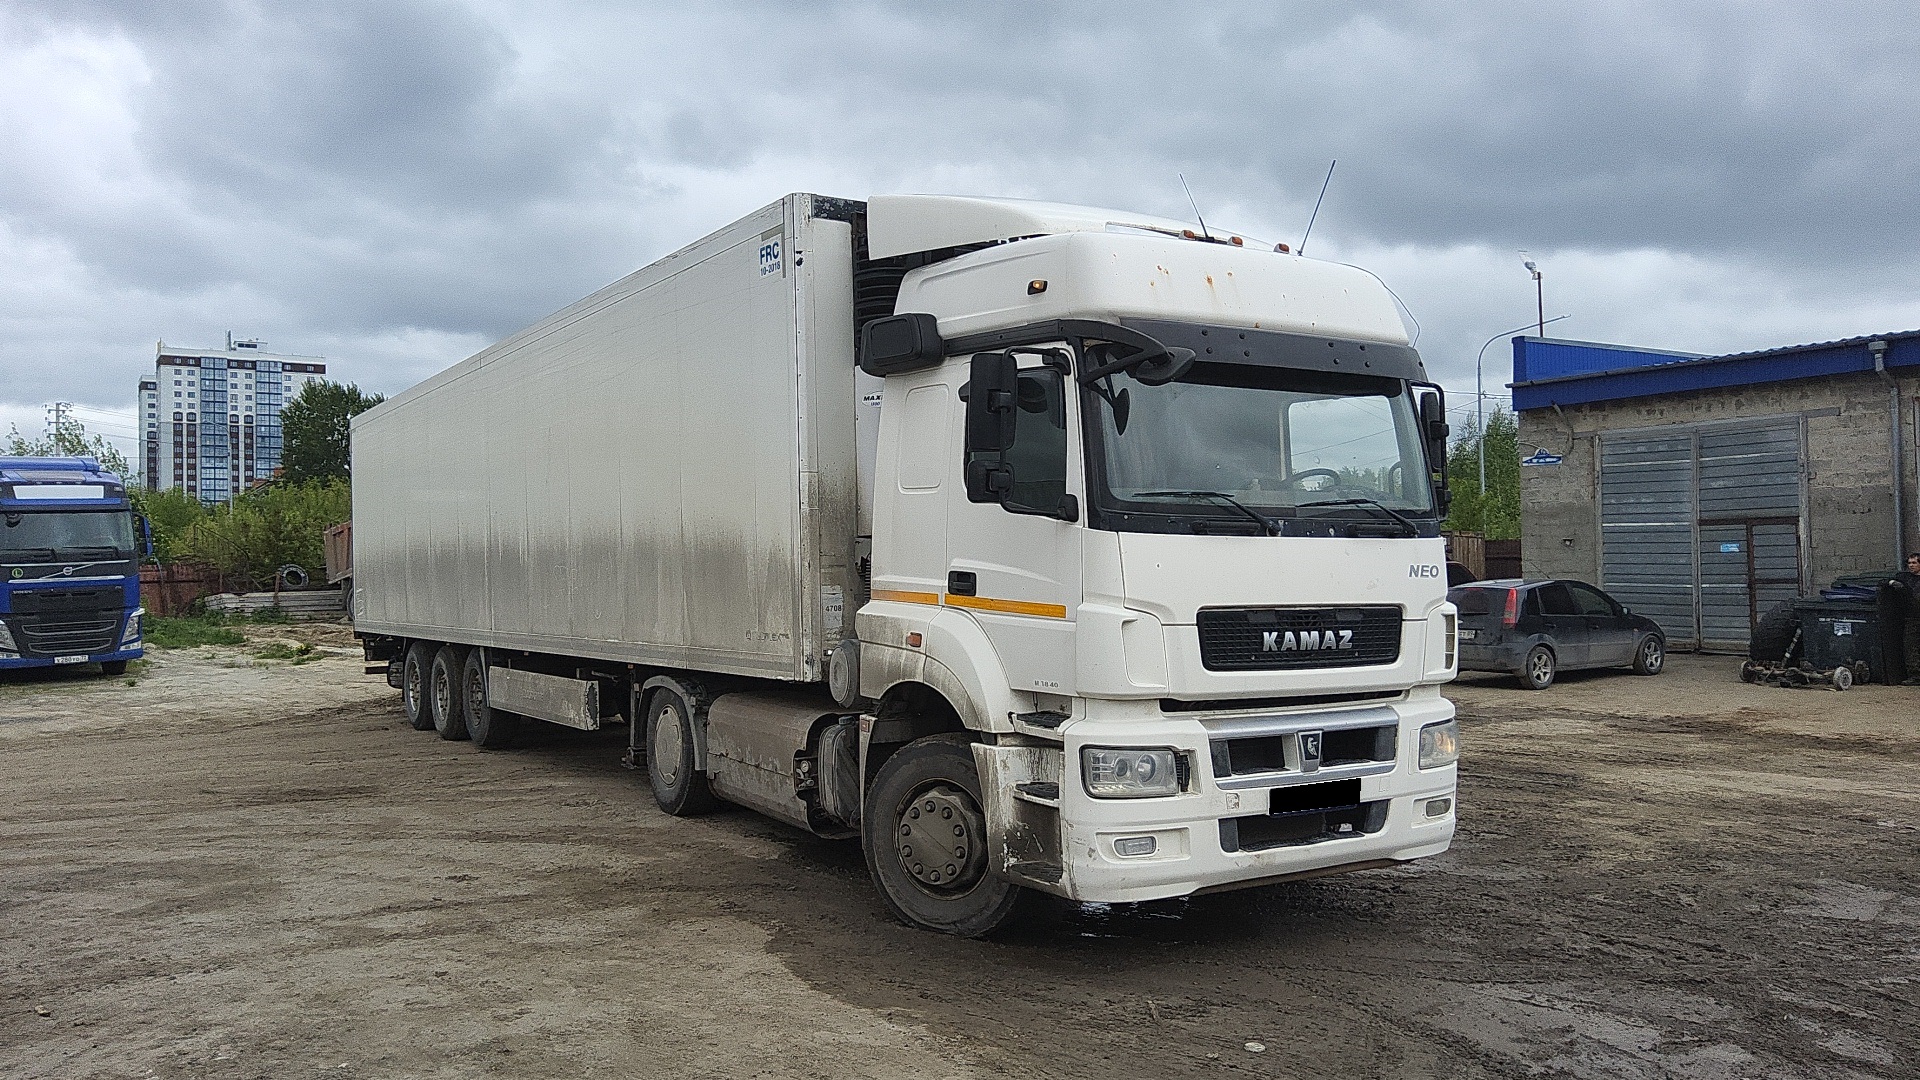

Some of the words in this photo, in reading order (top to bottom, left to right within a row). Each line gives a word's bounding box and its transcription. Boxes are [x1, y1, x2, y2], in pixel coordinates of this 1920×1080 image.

[760, 241, 780, 265] FRC
[760, 261, 781, 276] 10-2018
[1409, 564, 1439, 578] NEO
[825, 604, 842, 612] 4708
[1262, 629, 1353, 651] KAMAZ
